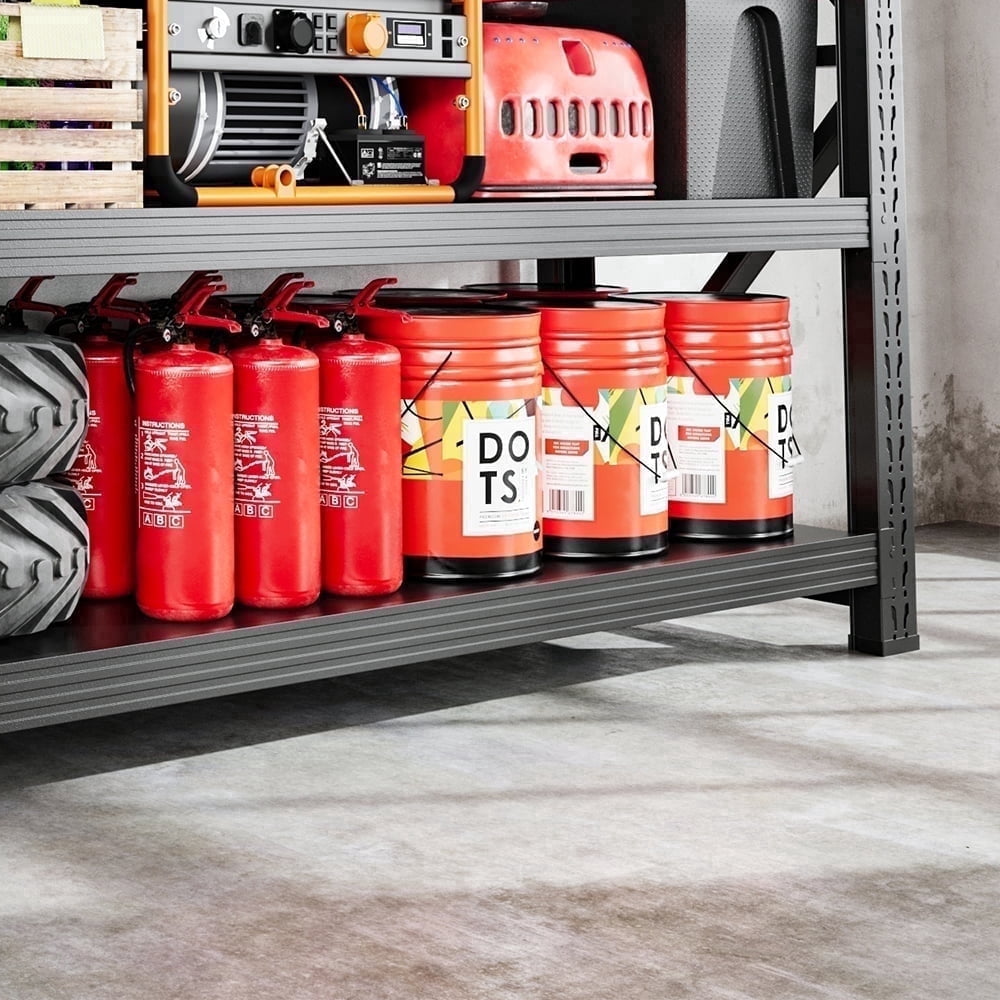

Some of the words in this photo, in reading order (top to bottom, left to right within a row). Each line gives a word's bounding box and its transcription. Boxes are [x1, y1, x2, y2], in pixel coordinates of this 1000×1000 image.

[141, 420, 186, 430] INSTRUCTIONS
[777, 404, 793, 434] D
[650, 415, 668, 447] D
[479, 430, 530, 465] DO
[331, 495, 339, 506] B
[345, 495, 355, 506] C
[246, 504, 255, 515] B
[261, 505, 271, 516] C
[144, 513, 152, 525] A
[156, 514, 165, 526] B
[171, 515, 182, 527] C
